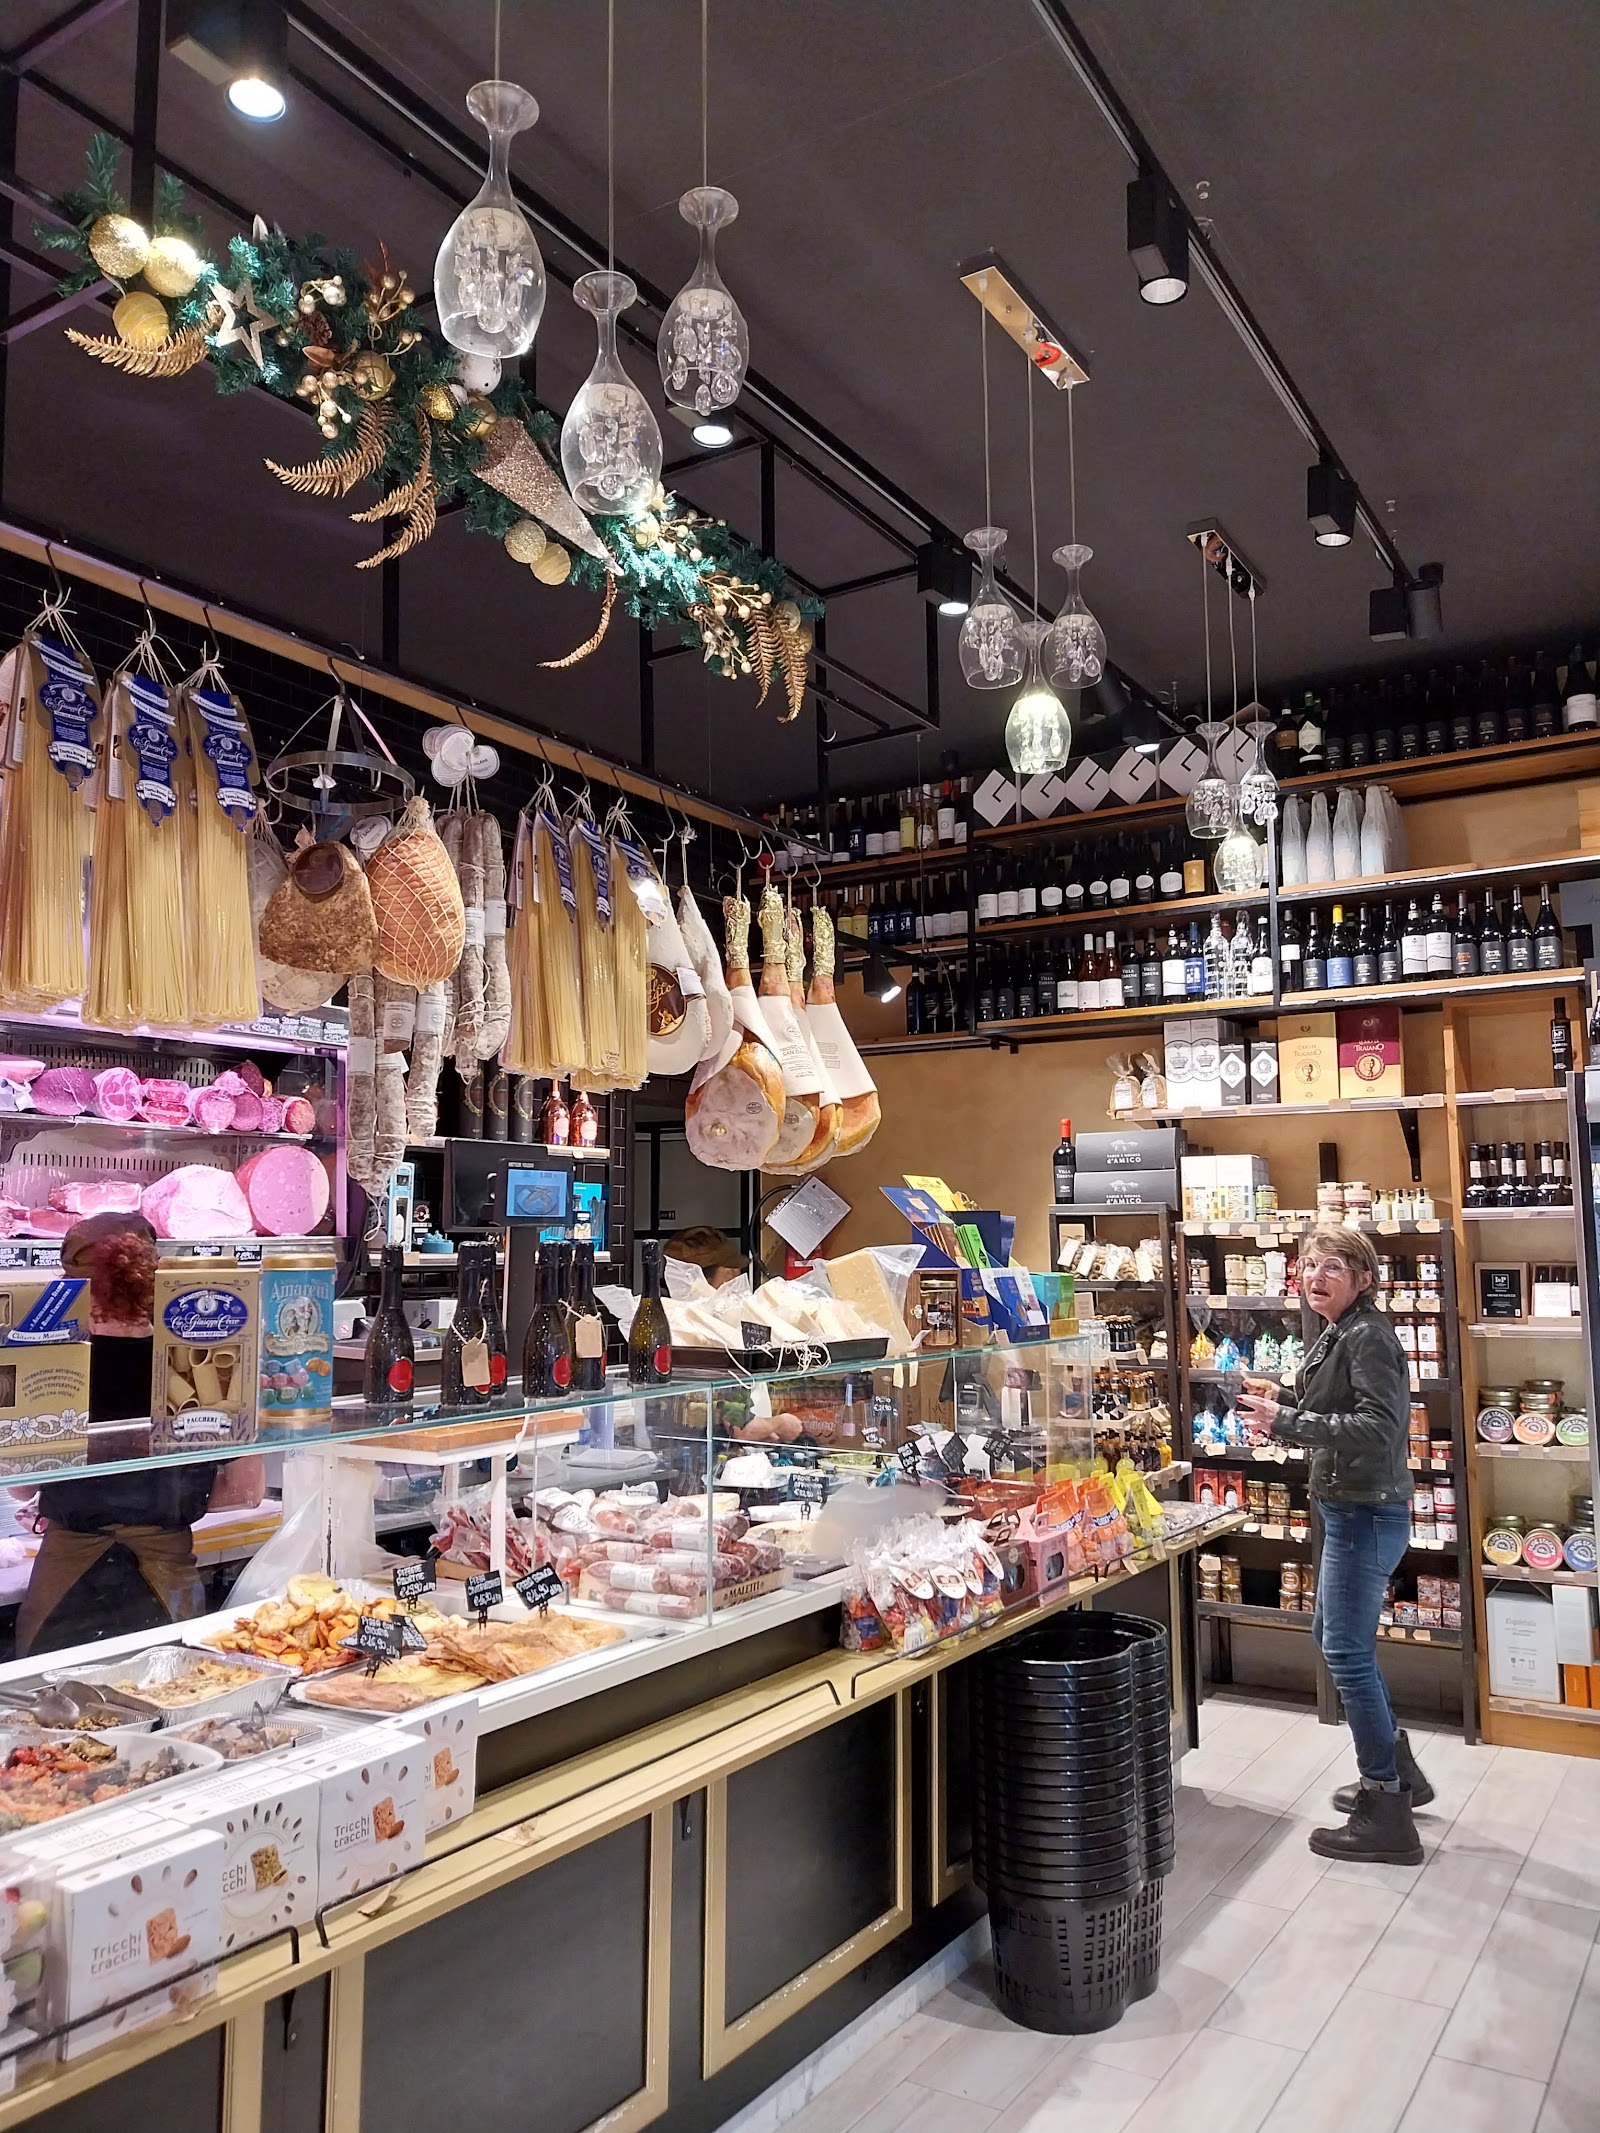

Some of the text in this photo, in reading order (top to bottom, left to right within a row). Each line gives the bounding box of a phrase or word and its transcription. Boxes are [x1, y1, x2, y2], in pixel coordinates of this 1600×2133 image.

[1353, 1043, 1385, 1053] TRAIANO
[729, 1581, 760, 1598] MALETTI
[361, 1615, 381, 1628] PIZZA
[334, 1815, 370, 1838] Tricchi
[334, 1827, 370, 1850] tracchi
[222, 1863, 248, 1882] cchi
[222, 1876, 248, 1893] cchi
[92, 1930, 142, 1961] Tricchi
[91, 1945, 142, 1975] tracchi
